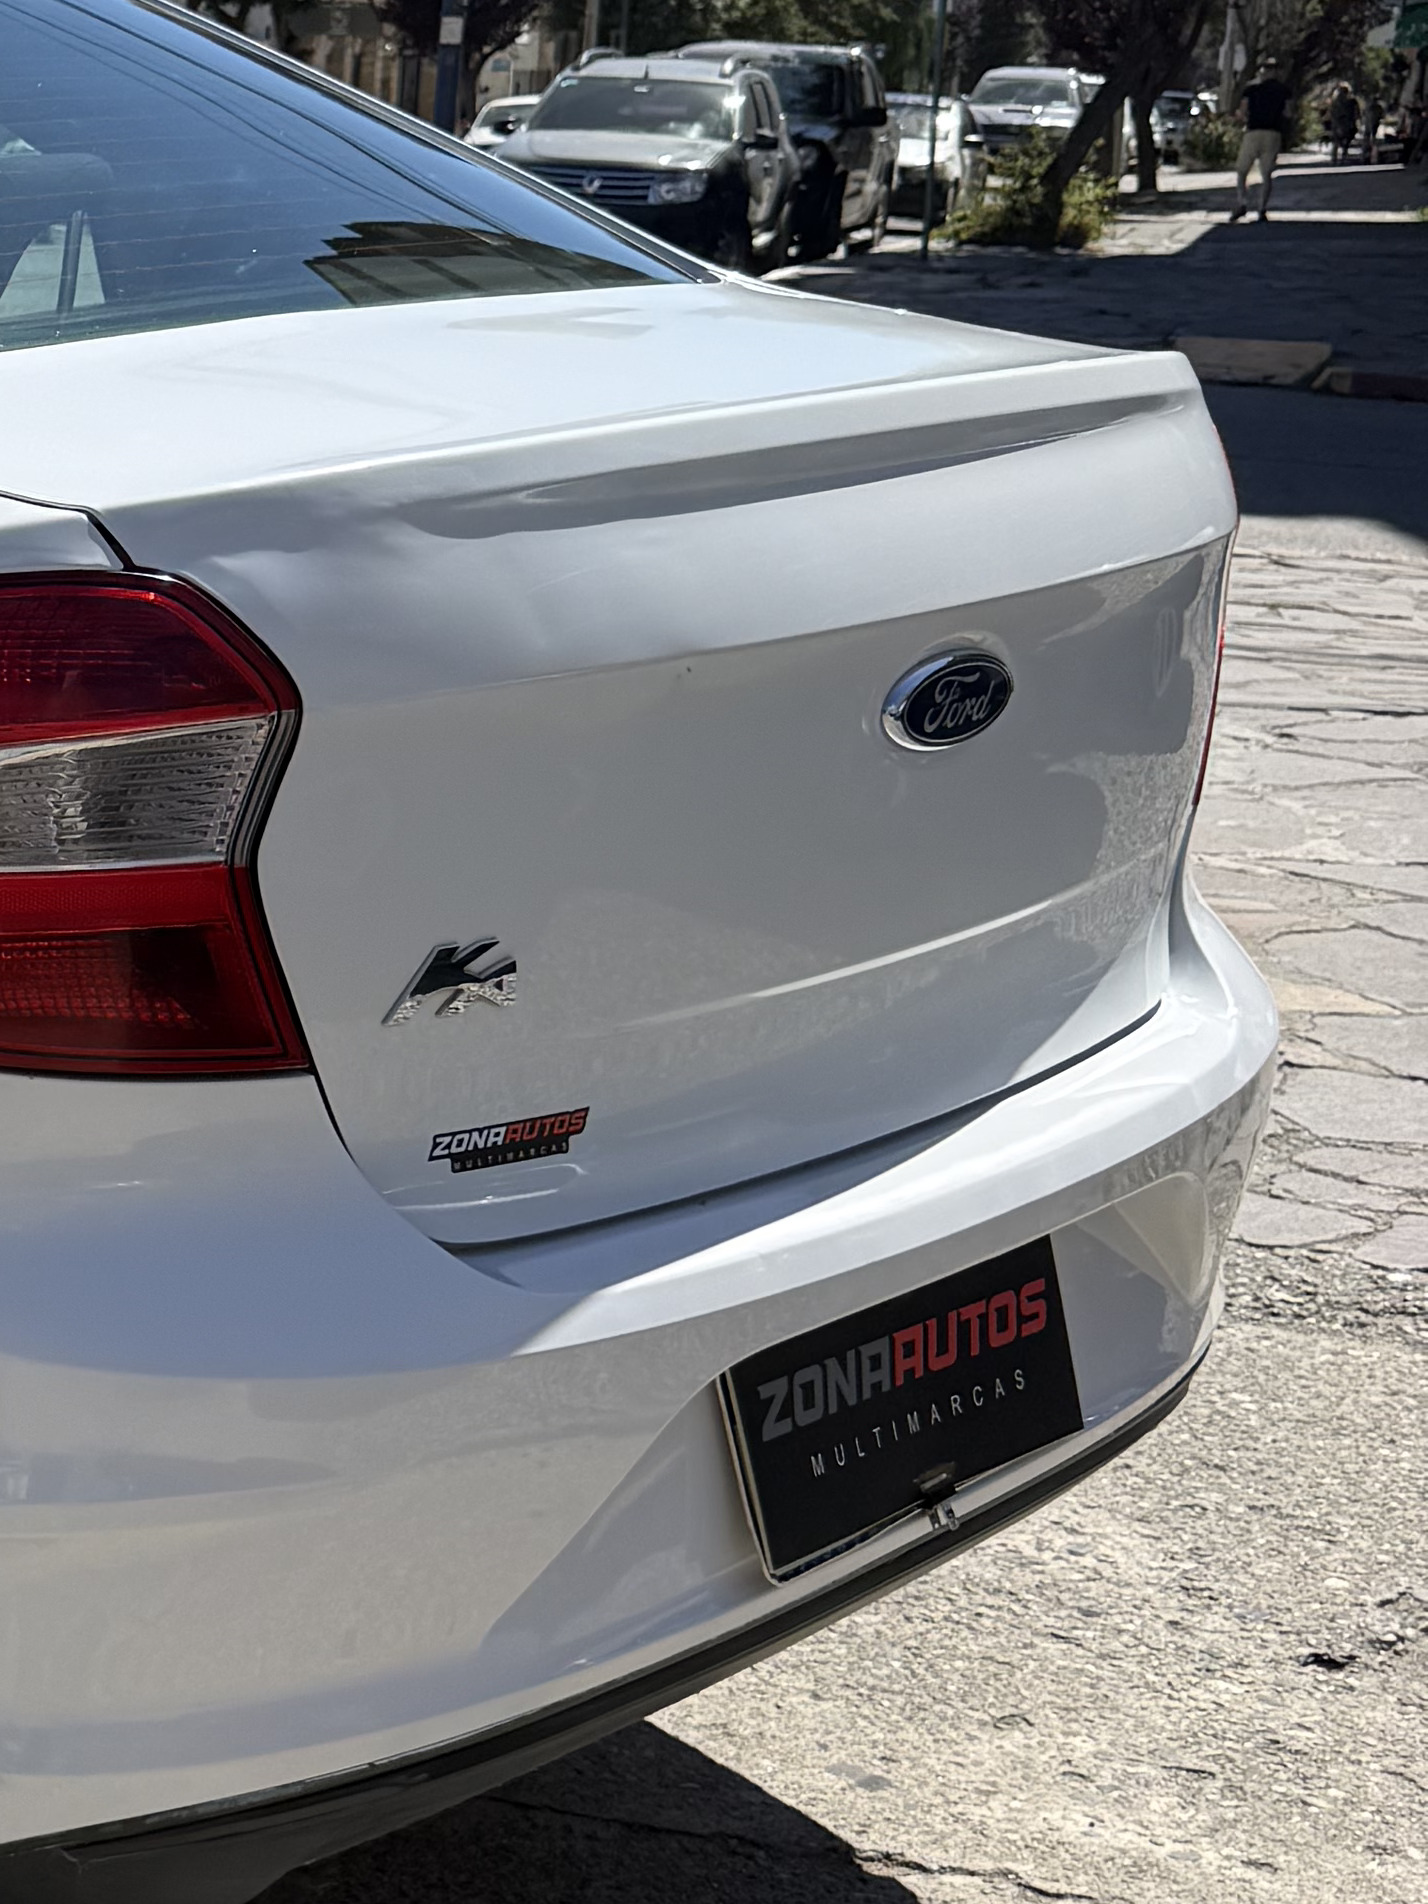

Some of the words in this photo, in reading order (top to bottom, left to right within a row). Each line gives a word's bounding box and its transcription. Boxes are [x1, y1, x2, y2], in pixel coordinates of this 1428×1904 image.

[924, 671, 995, 733] Ford
[454, 1140, 568, 1171] MULTIMARCAS
[810, 1368, 1026, 1478] MULTIMARCAS
